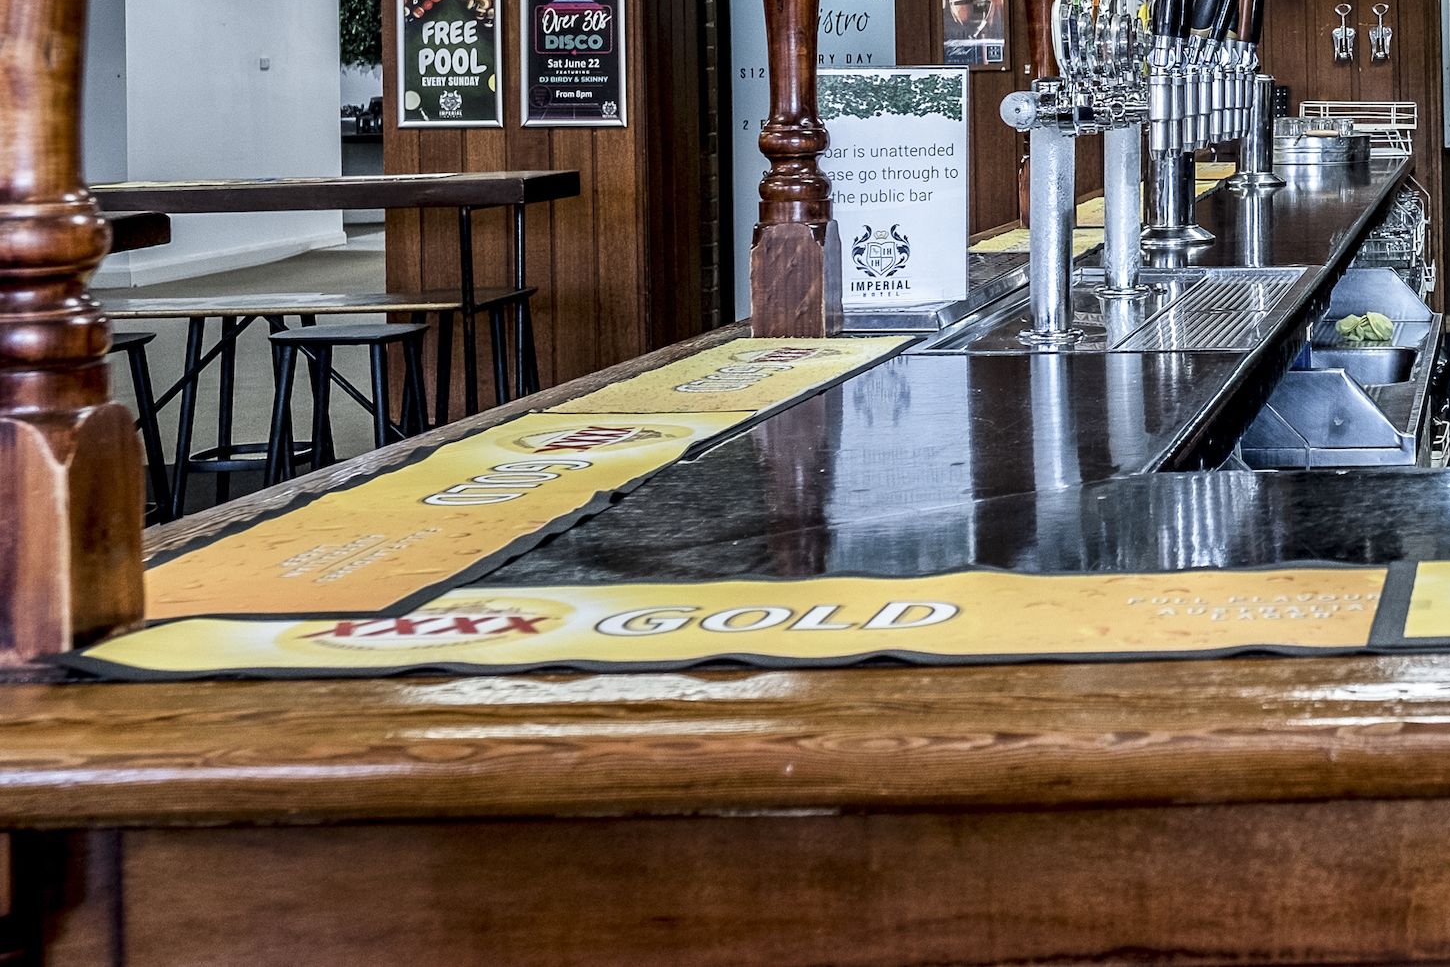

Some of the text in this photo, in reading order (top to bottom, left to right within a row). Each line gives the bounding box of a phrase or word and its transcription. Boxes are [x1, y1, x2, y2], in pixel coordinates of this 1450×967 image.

[542, 8, 612, 34] Over 30s
[818, 8, 871, 36] istro
[422, 20, 478, 45] FREE
[545, 34, 603, 50] DISCO
[418, 47, 487, 75] POOL
[547, 59, 600, 69] Sat June 22
[846, 53, 873, 65] DAY
[422, 76, 479, 87] EVERY SUNDAY
[556, 90, 575, 98] From
[576, 90, 593, 99] 8pm
[824, 144, 955, 159] bar is unattended
[828, 166, 959, 184] ase go through to
[832, 189, 933, 206] the public bar
[851, 280, 911, 292] IMPERIAL
[418, 459, 593, 506] GOLD
[308, 614, 548, 637] XXXX
[594, 601, 961, 637] GOLD
